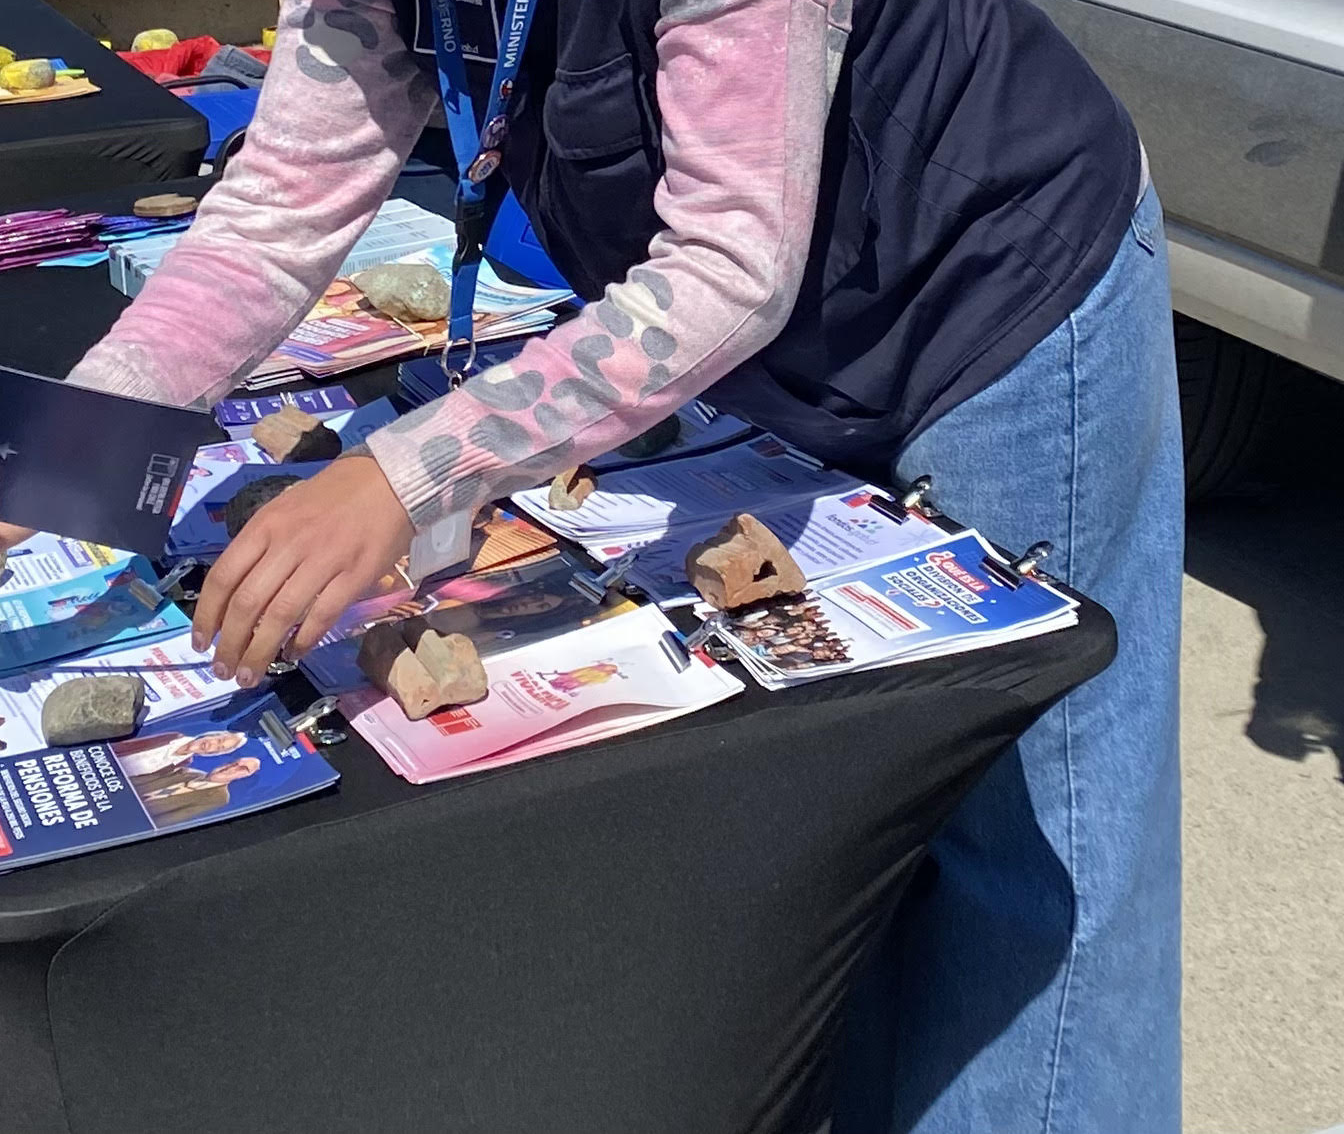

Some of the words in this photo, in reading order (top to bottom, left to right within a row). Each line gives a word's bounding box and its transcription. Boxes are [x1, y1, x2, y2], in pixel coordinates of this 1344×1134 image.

[42, 754, 88, 811] REFORMA
[69, 809, 99, 829] DE
[69, 749, 102, 791] BENEFICIOS
[87, 745, 117, 778] CONOCE
[102, 776, 124, 793] LOS
[14, 758, 65, 826] PENSIONES
[90, 789, 109, 802] DE
[96, 800, 113, 812] LA
